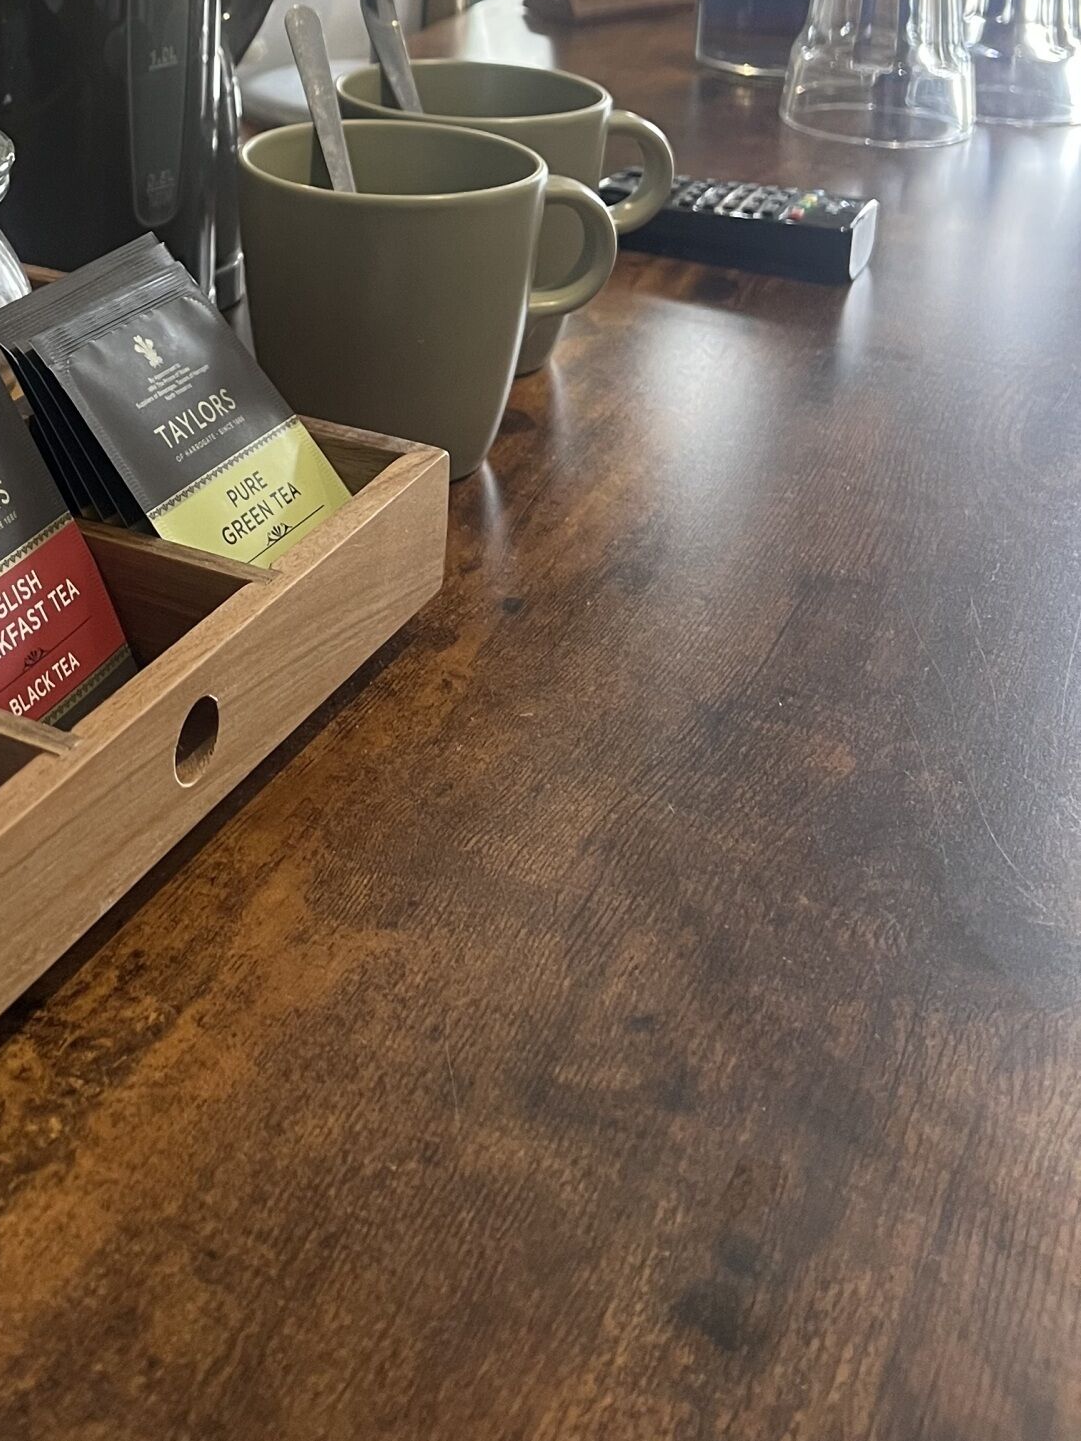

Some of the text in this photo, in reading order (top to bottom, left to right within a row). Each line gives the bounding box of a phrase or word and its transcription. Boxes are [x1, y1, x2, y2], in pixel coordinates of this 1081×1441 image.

[153, 388, 236, 449] TAYLORS
[221, 481, 302, 545] GREEN TEA
[226, 470, 268, 508] PURE
[47, 578, 80, 612] TEA
[8, 652, 81, 717] BLACK TEA
